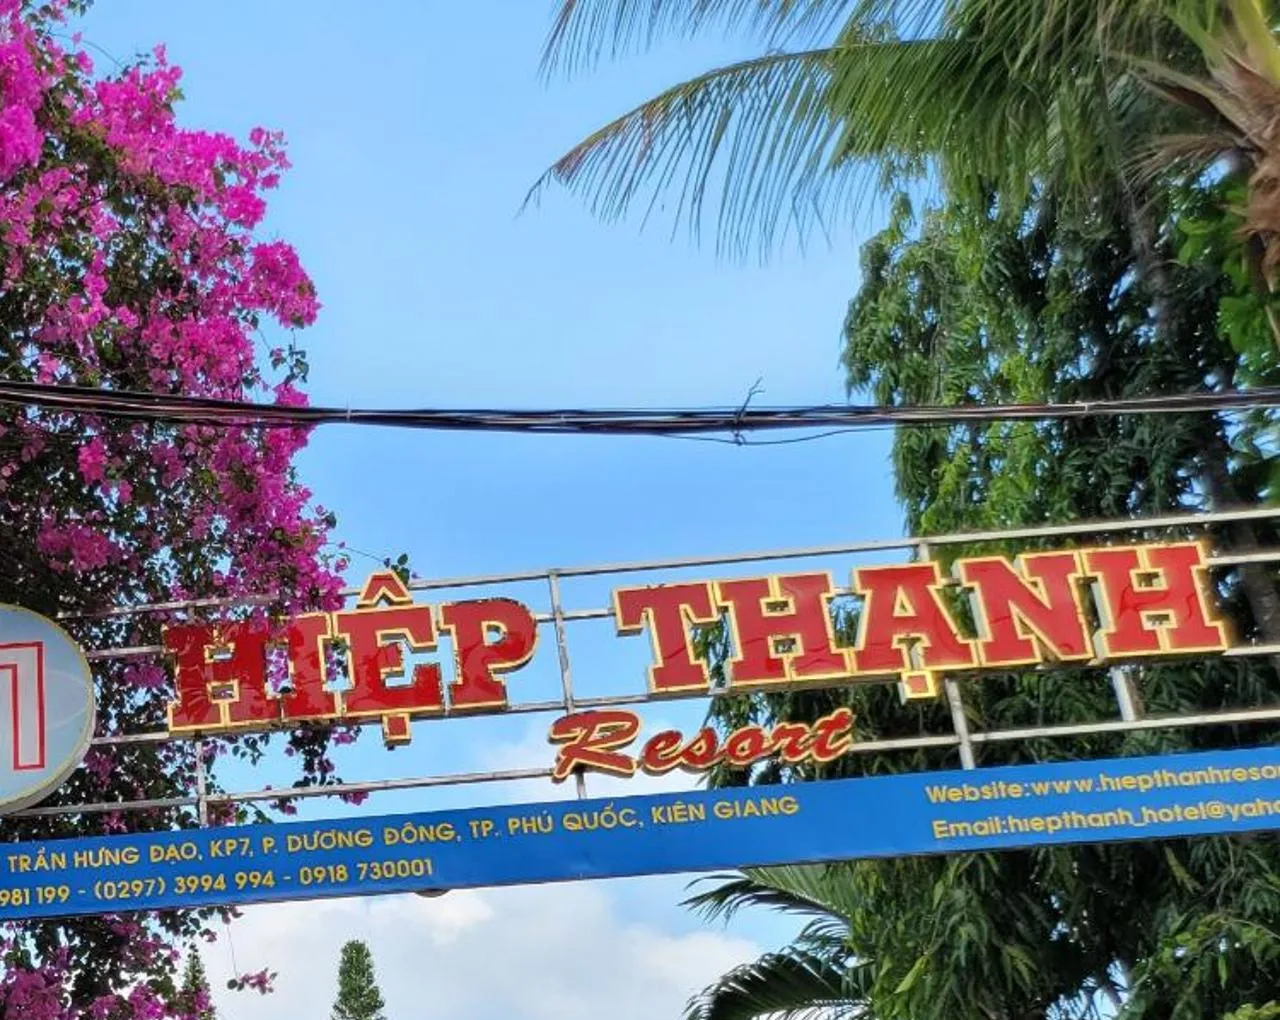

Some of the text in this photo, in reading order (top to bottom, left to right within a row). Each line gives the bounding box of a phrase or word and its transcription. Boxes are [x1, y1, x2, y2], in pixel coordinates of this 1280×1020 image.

[163, 540, 1230, 751] HIỆP THẠNH
[550, 708, 857, 782] Resort
[925, 765, 1280, 803] Website:www.hiepthanhreso
[74, 846, 139, 868] HƯNG
[210, 838, 254, 858] KP7,
[262, 837, 278, 854] P.
[287, 829, 373, 853] DƯƠNG
[469, 820, 501, 839] TP.
[508, 811, 554, 835] PHÚ
[562, 801, 645, 831] QUỐC,
[651, 802, 706, 824] KIÊN
[713, 795, 800, 819] GIANG
[35, 885, 70, 904] 199
[94, 876, 165, 900] (0297)
[174, 873, 226, 895] 3994
[235, 870, 275, 890] 994
[299, 864, 349, 885] 0918
[356, 858, 433, 881] 730001
